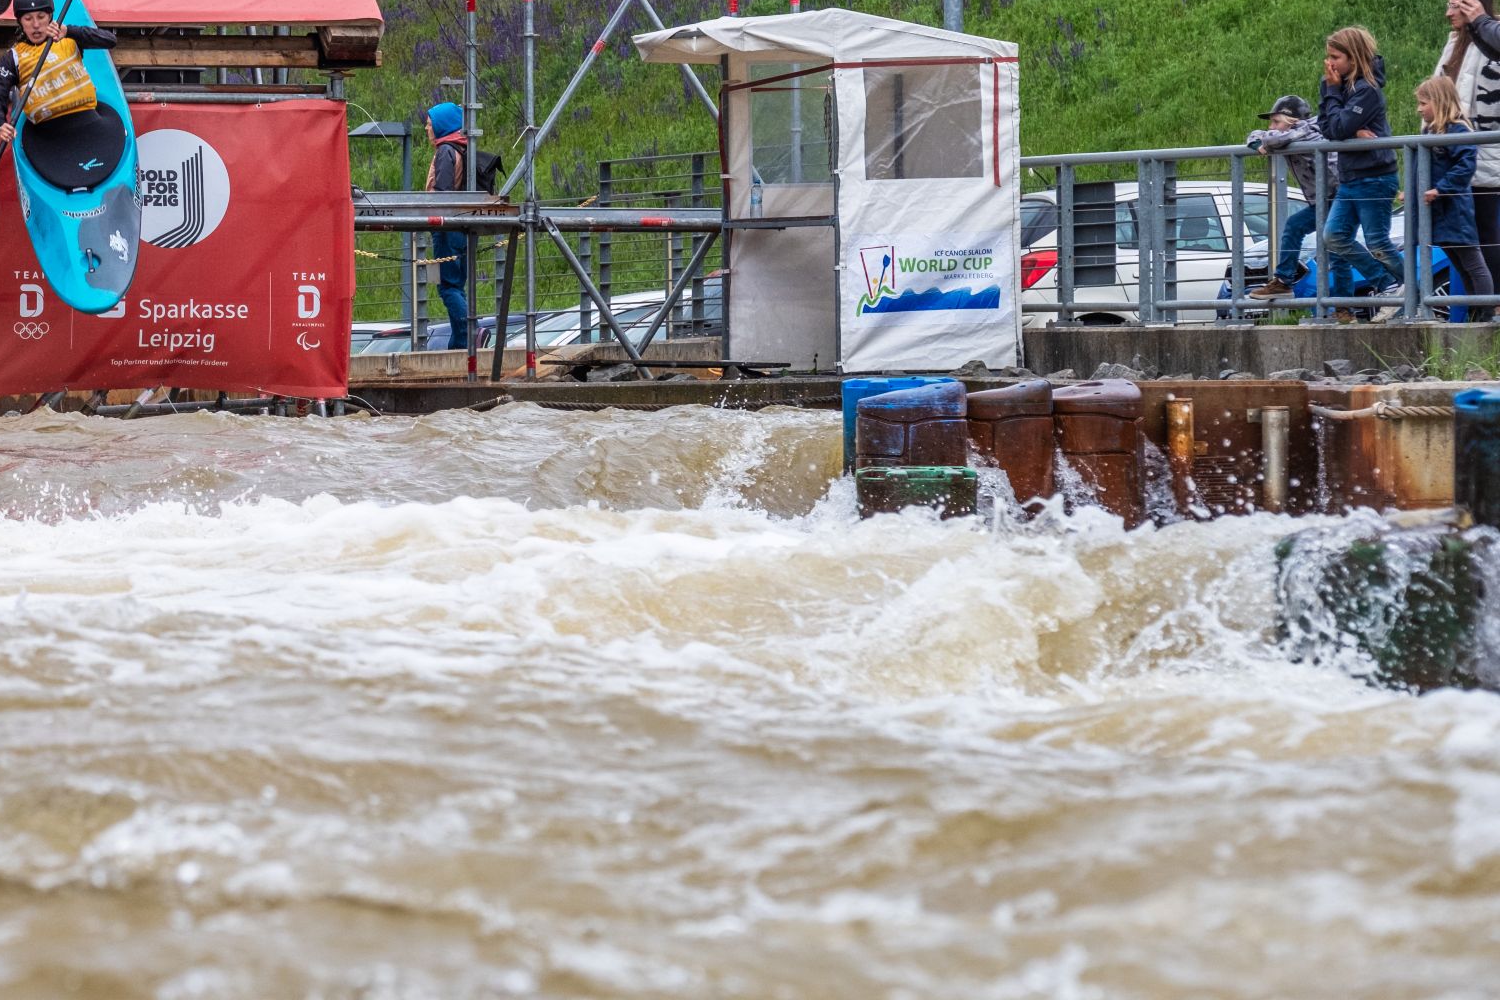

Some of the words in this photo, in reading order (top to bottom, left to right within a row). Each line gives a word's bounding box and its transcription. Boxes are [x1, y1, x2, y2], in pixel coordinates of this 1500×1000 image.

[147, 183, 179, 194] FOR
[899, 257, 958, 273] WORLD
[963, 257, 993, 271] CUP
[293, 272, 326, 280] TEAM
[139, 298, 248, 320] Sparkasse
[138, 328, 215, 352] Leipzig
[110, 358, 122, 367] Top
[123, 358, 148, 367] Partner
[149, 358, 163, 367] und
[164, 358, 199, 367] Nationaler
[201, 358, 228, 367] Förderer
